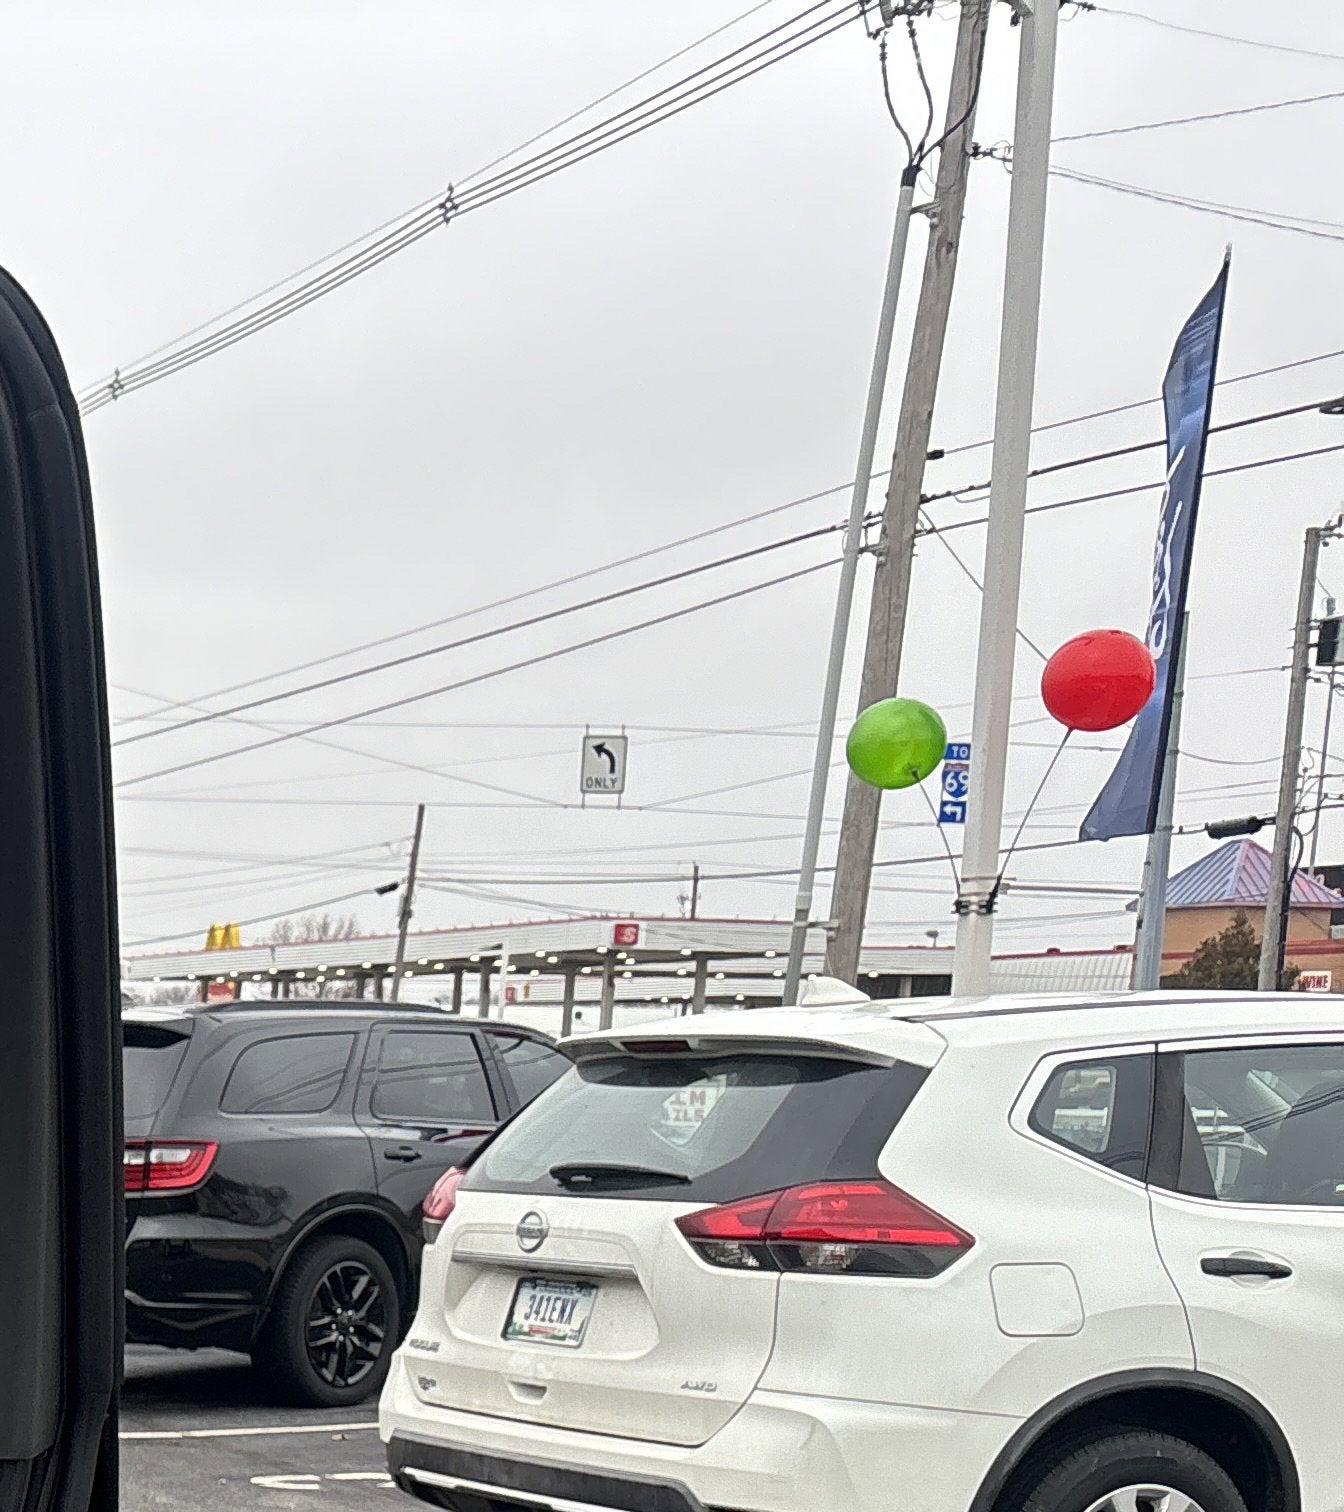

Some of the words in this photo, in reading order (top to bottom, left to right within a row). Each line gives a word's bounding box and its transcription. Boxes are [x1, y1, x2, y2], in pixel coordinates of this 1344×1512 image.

[952, 746, 969, 758] TO
[585, 777, 618, 789] ONLY
[945, 772, 969, 793] 69
[524, 1294, 577, 1324] 341ENX
